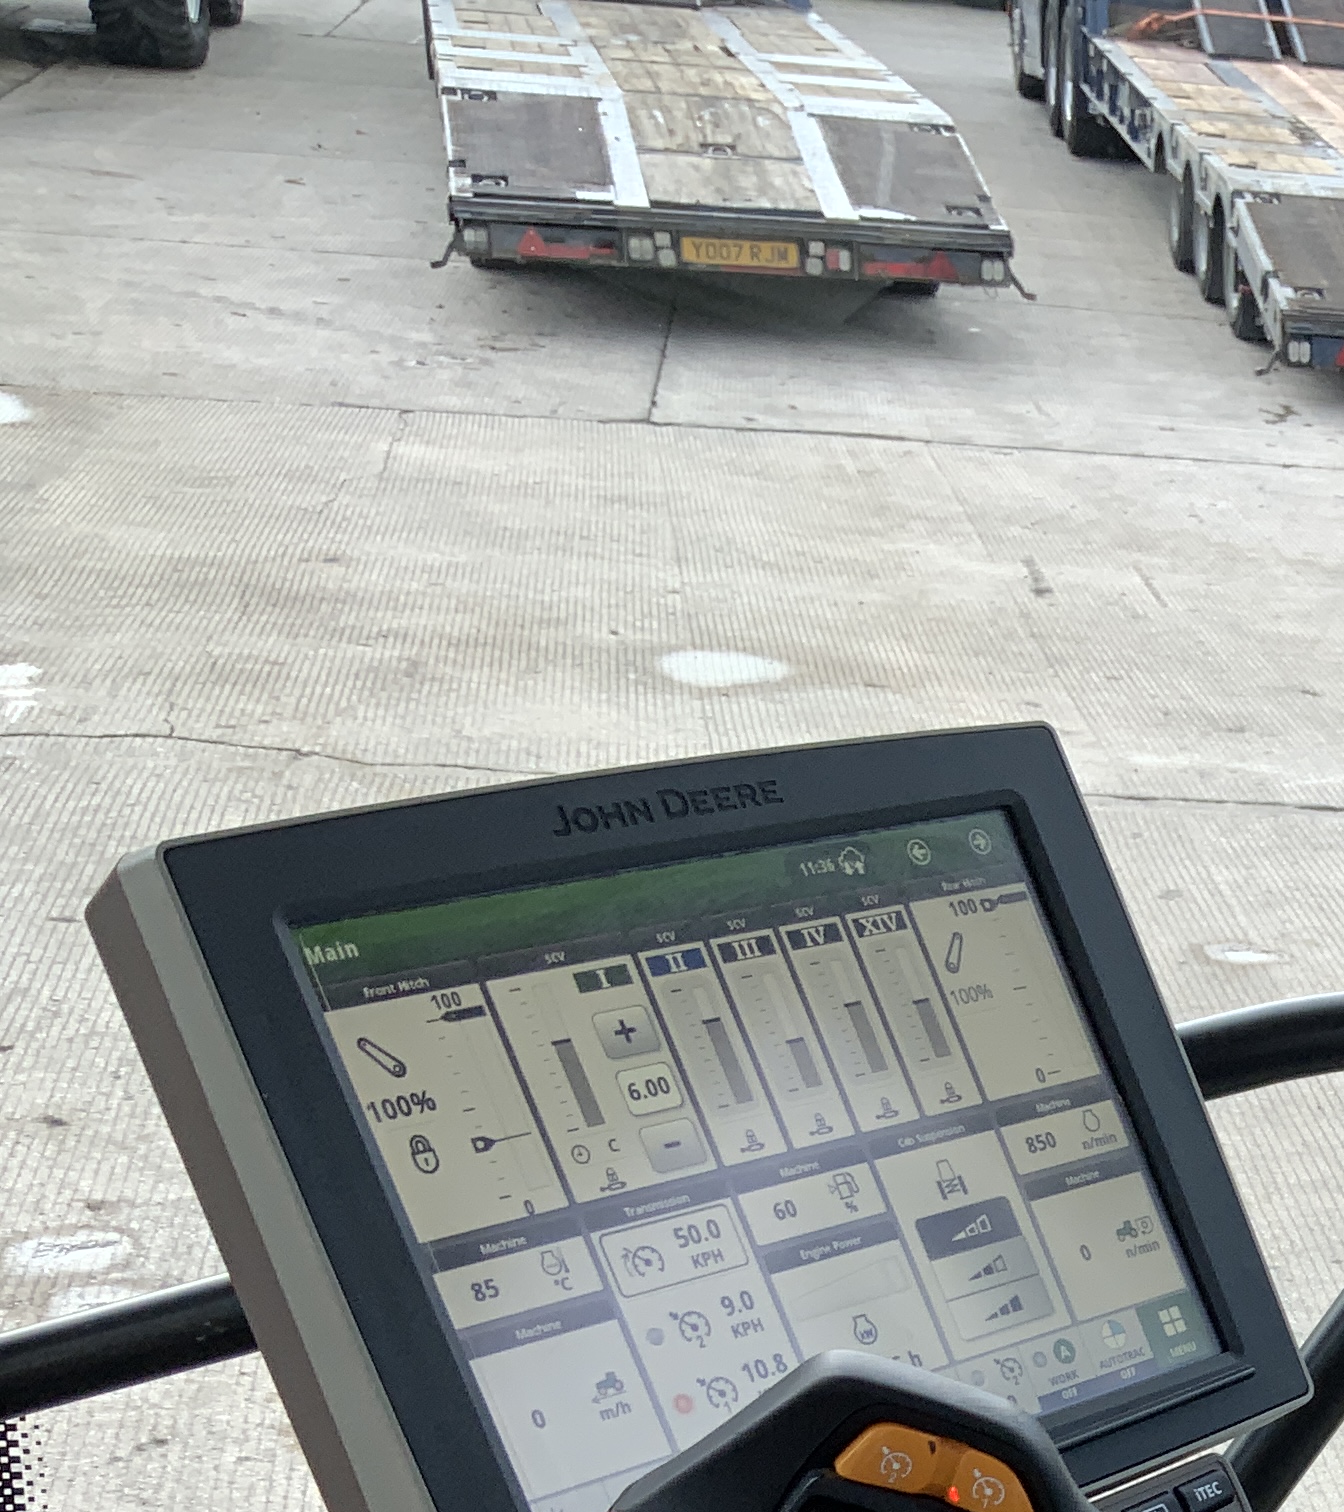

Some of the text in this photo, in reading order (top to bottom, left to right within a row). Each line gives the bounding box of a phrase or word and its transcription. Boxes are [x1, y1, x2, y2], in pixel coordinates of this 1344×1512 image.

[553, 780, 784, 837] JOHN DEERE
[949, 898, 978, 918] 100
[860, 912, 901, 937] XIV
[801, 927, 826, 946] IV
[303, 940, 359, 966] Main
[732, 941, 761, 961] III
[666, 952, 688, 972] II
[430, 991, 462, 1011] 100
[950, 983, 994, 1007] 100%
[1035, 1067, 1046, 1084] 0
[627, 1076, 671, 1101] 6.00
[367, 1090, 437, 1123] 100%
[1025, 1131, 1057, 1154] 850
[1082, 1131, 1118, 1151] n/min
[773, 1199, 797, 1221] 60
[673, 1219, 722, 1248] 50.0
[1079, 1244, 1092, 1261] 0
[1125, 1238, 1161, 1259] n/min
[691, 1249, 724, 1270] KPH
[470, 1278, 500, 1302] 85
[720, 1290, 754, 1316] 9.0
[730, 1317, 765, 1340] KPH
[1099, 1347, 1146, 1369] AUTOTRAC
[1169, 1340, 1197, 1357] MENU
[741, 1353, 788, 1383] 10.8
[1048, 1369, 1080, 1387] WORK
[531, 1409, 546, 1429] 0
[599, 1400, 632, 1421] m/h
[1193, 1481, 1223, 1502] iTEC
